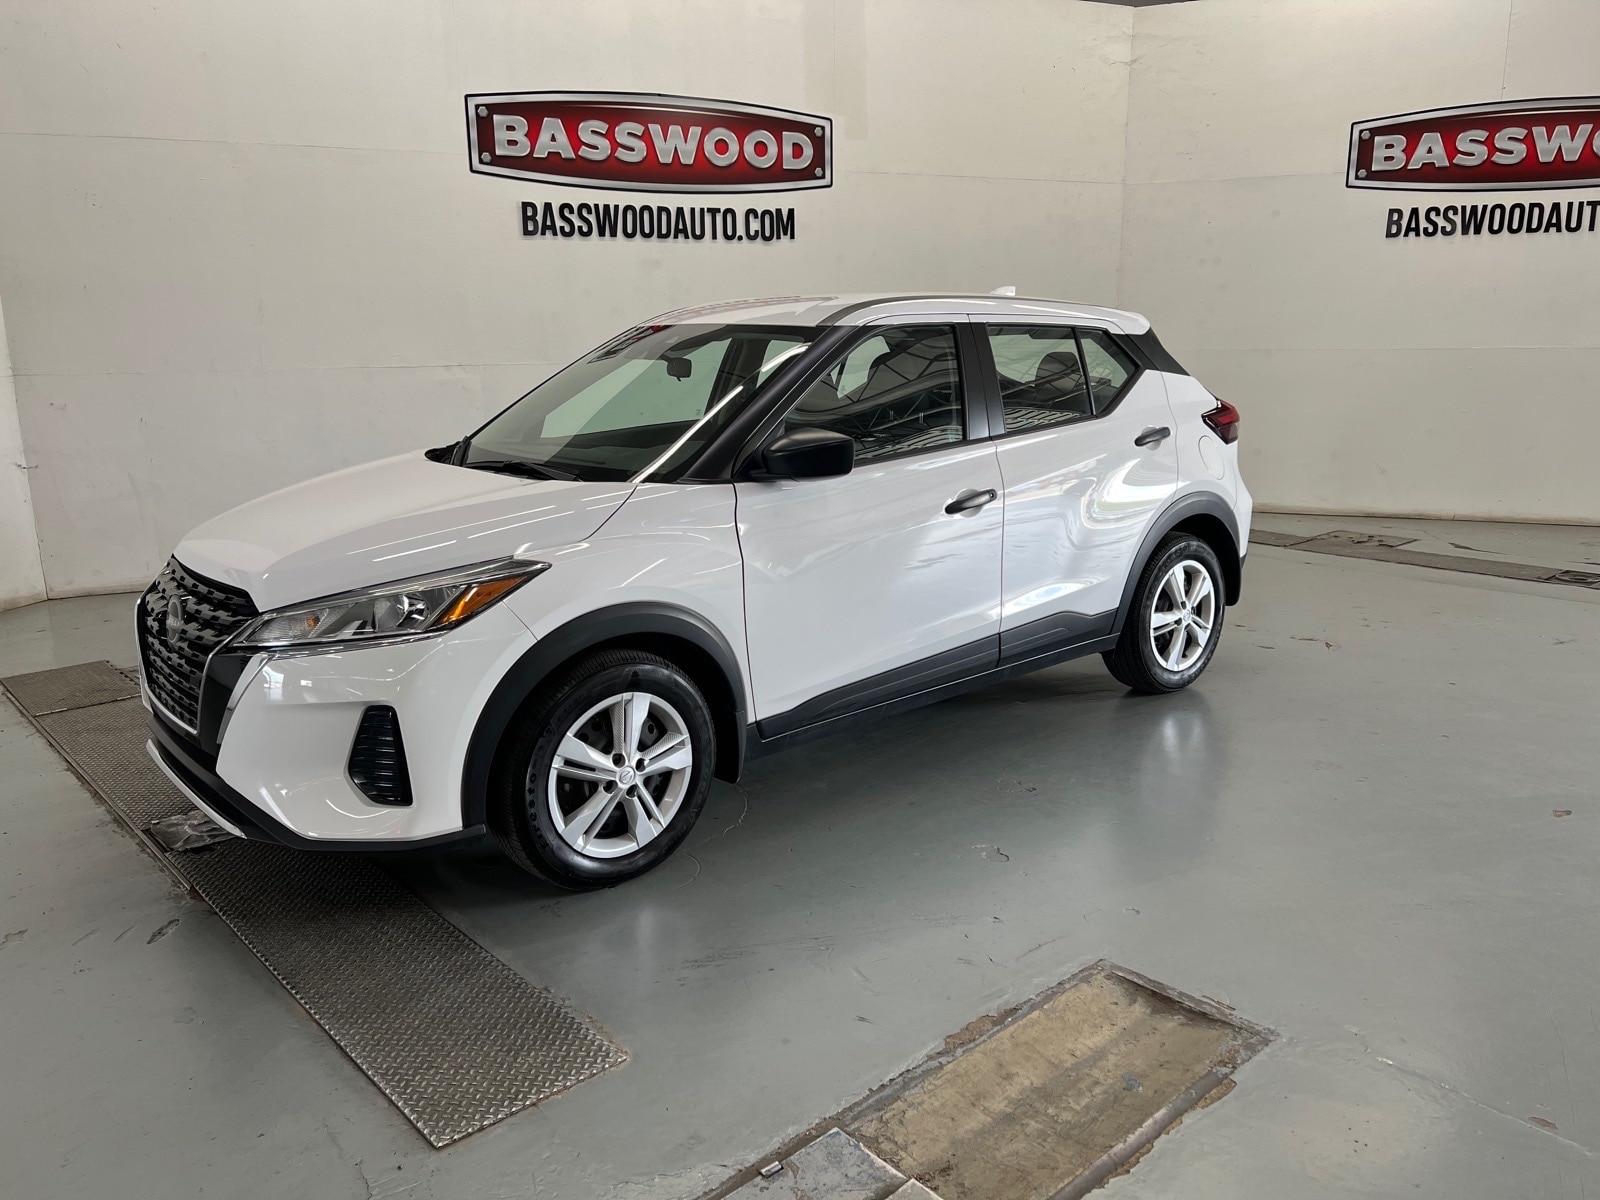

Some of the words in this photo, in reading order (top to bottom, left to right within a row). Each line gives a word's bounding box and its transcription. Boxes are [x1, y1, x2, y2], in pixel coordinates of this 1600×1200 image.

[492, 114, 814, 170] BASSWOOD
[1371, 123, 1600, 172] BASSW
[521, 201, 796, 241] BASSWOODAUTO.COM
[527, 745, 550, 851] Firesto
